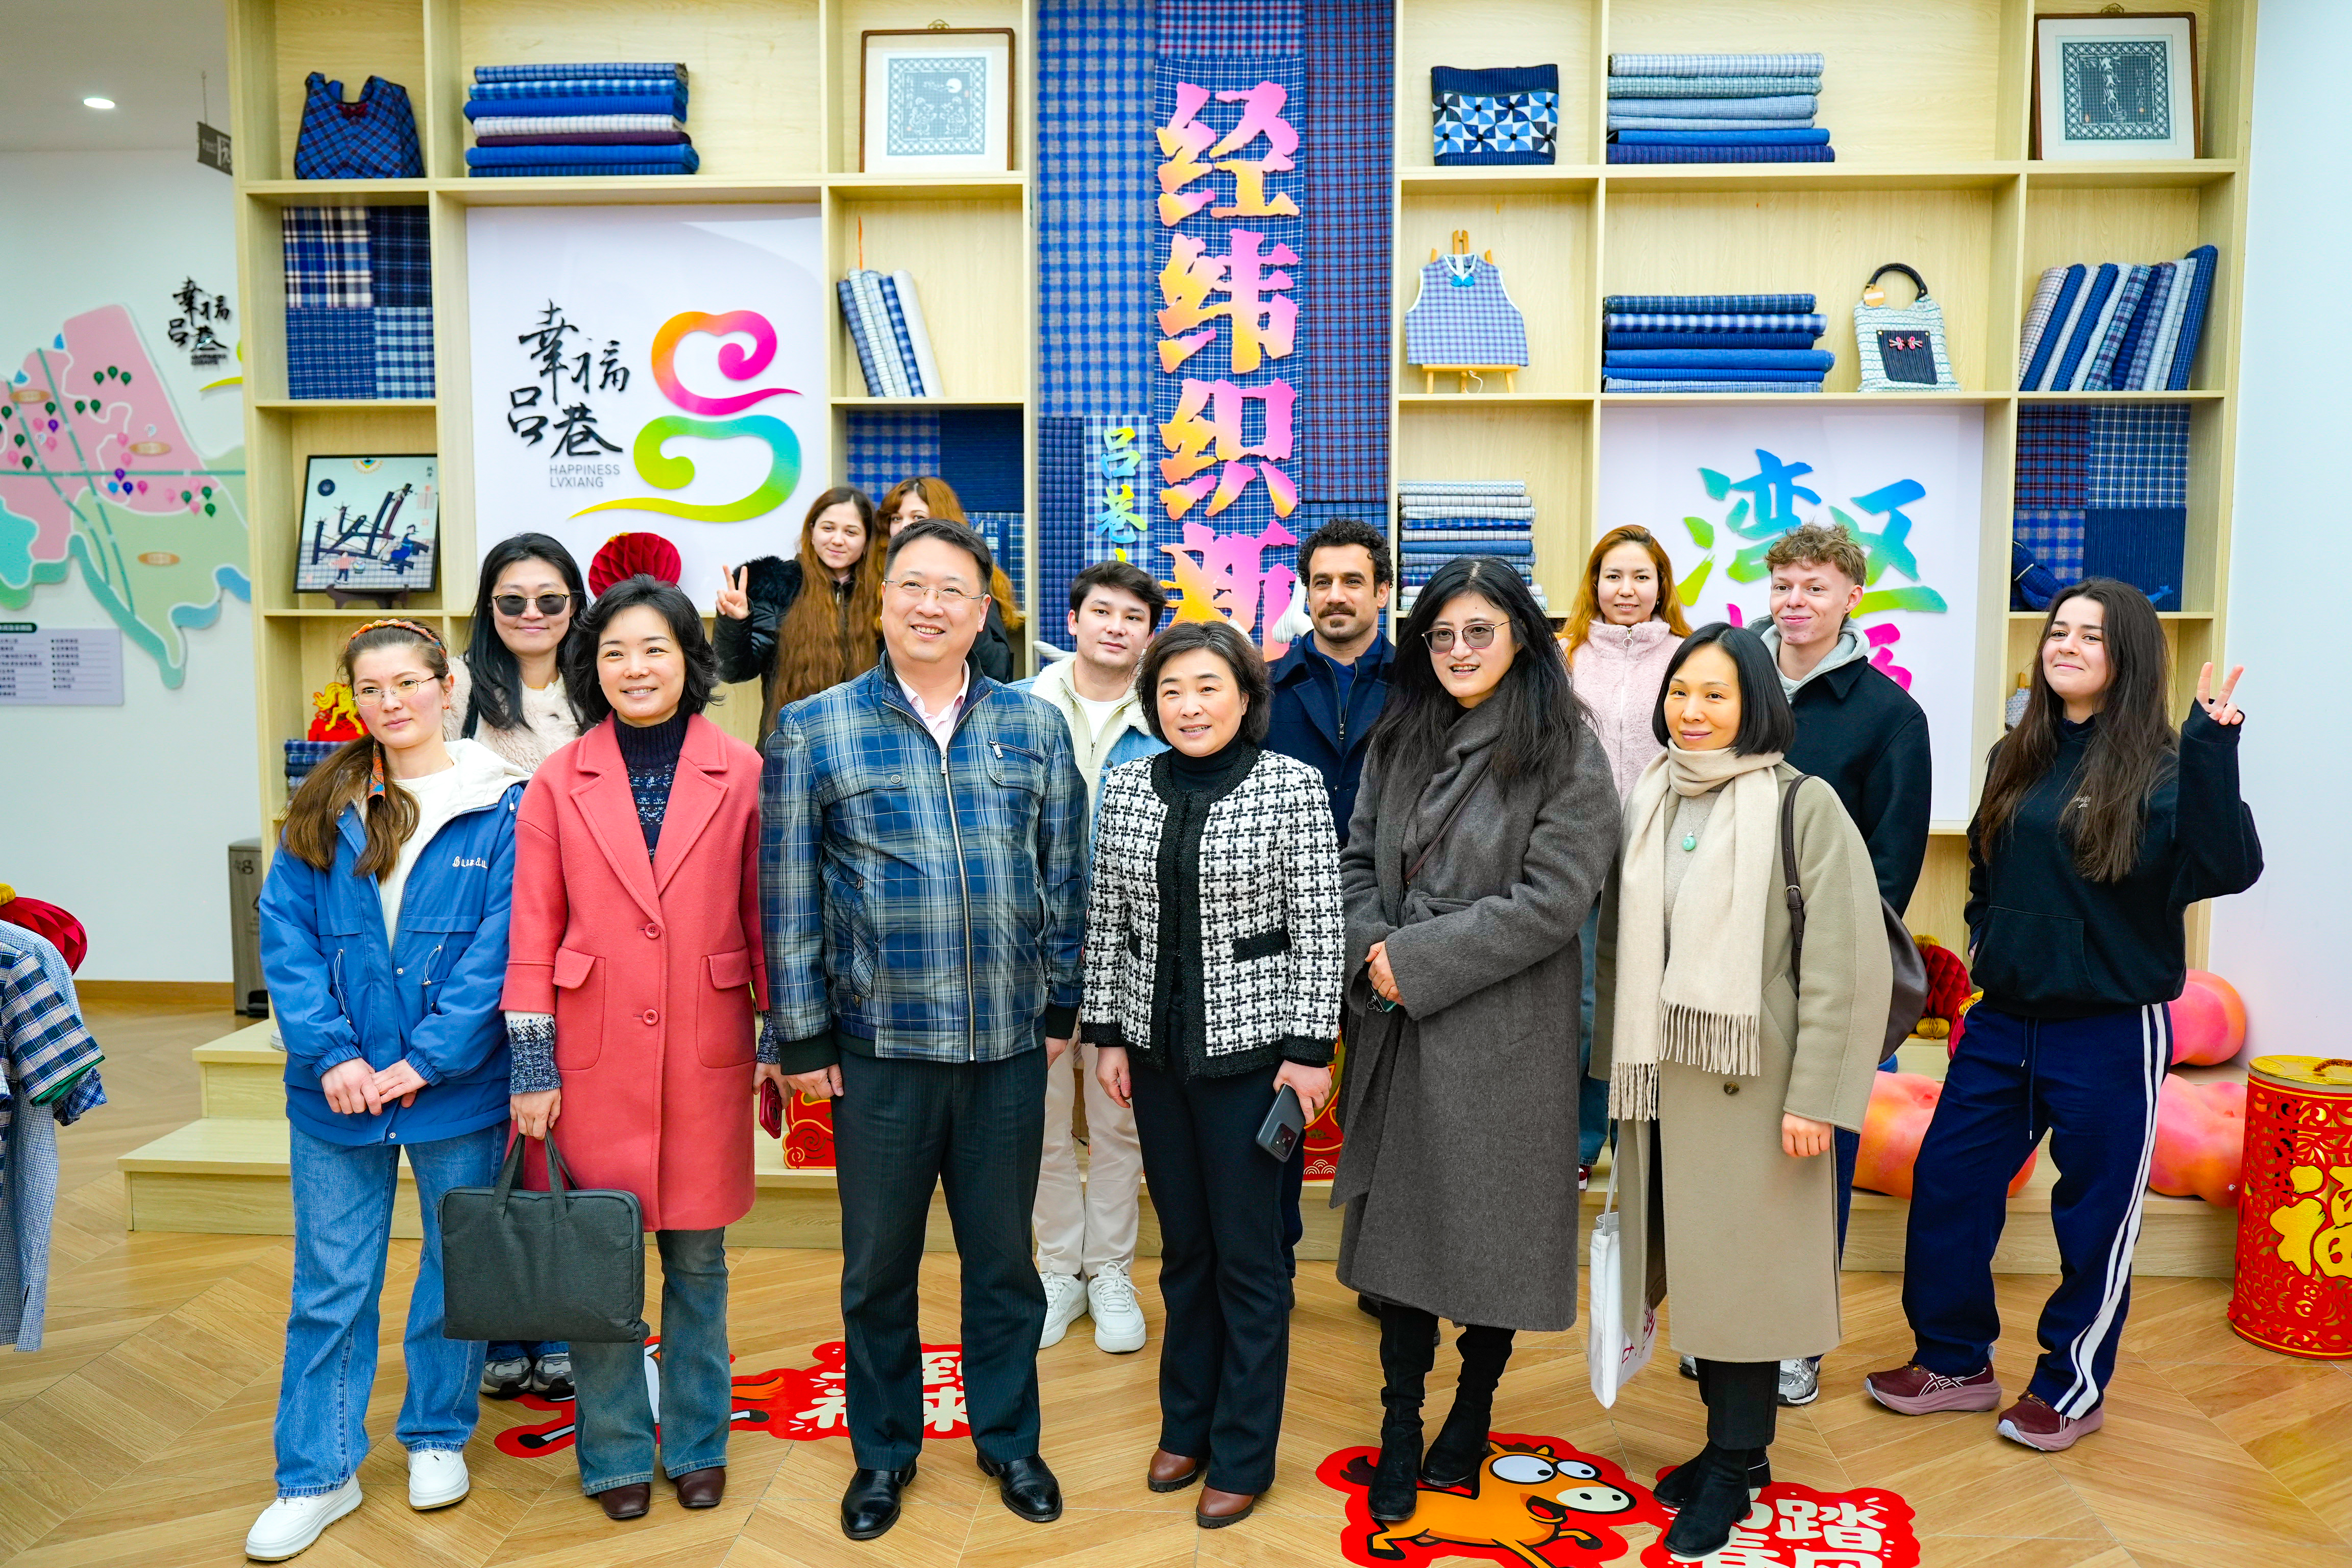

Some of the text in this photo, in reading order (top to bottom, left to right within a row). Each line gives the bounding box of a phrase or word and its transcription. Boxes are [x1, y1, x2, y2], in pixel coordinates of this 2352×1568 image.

[519, 299, 630, 405] 幸福
[508, 386, 623, 458] 吕巷
[549, 464, 620, 475] HAPPINESS
[550, 477, 603, 487] LVXIANG
[1095, 427, 1147, 563] 吕巷
